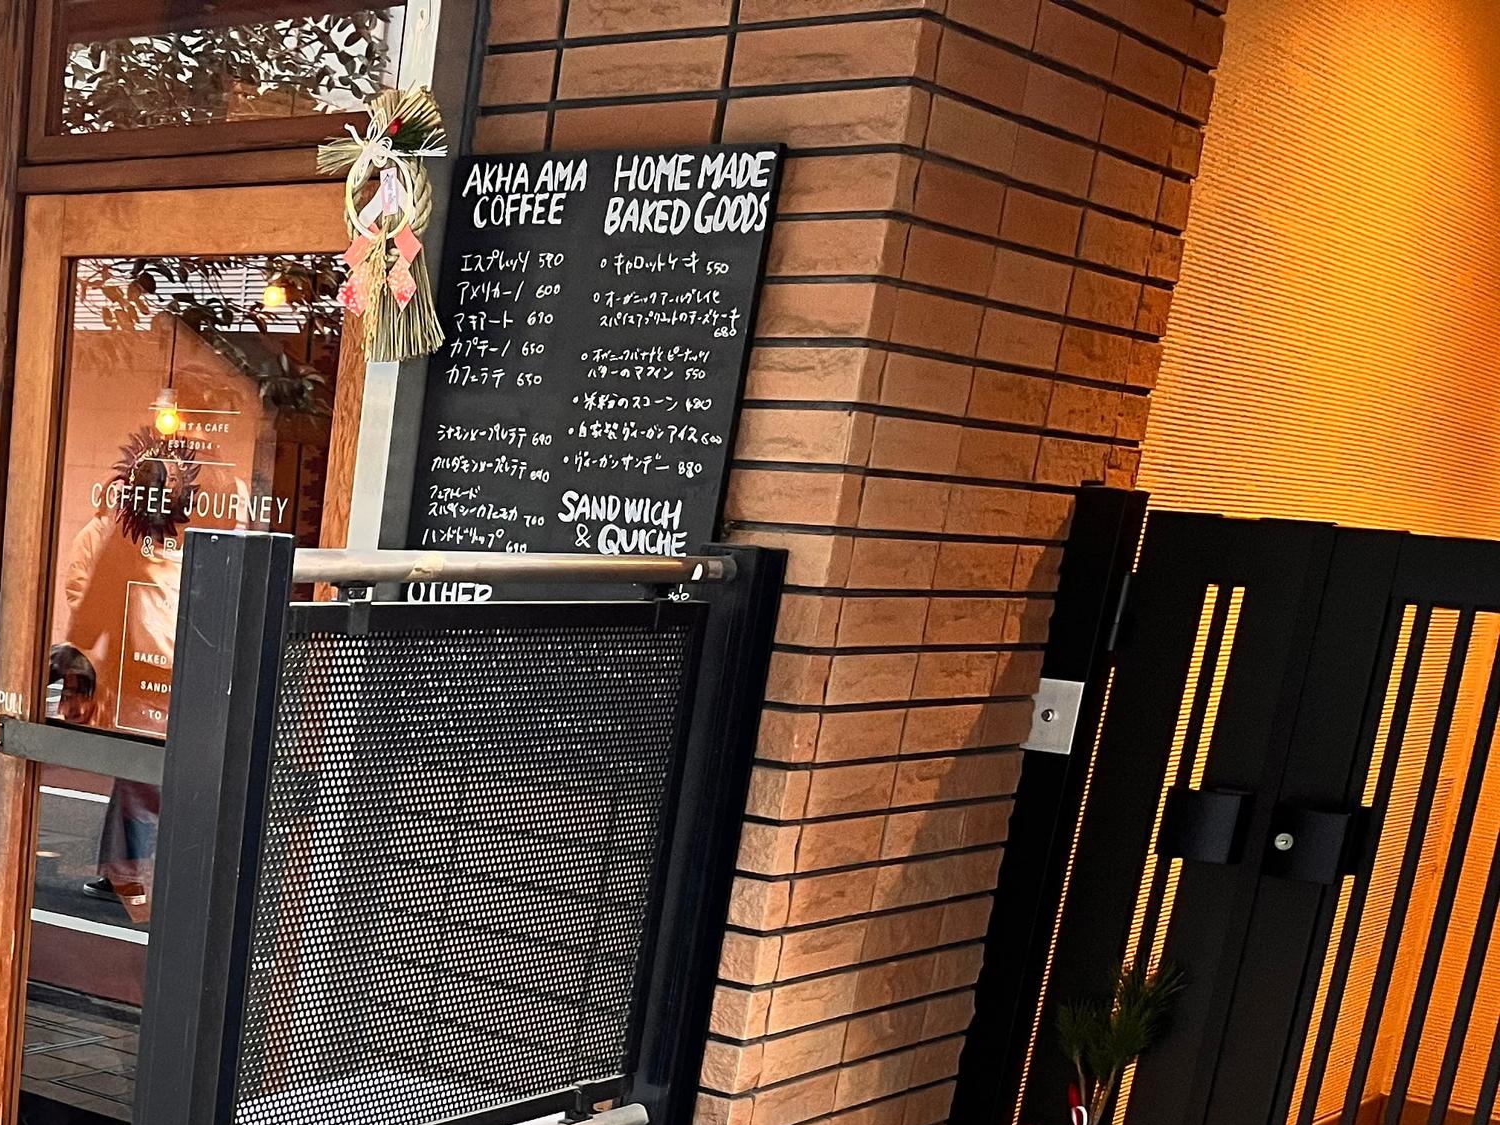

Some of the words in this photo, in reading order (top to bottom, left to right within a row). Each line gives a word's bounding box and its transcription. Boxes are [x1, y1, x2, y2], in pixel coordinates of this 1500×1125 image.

[462, 162, 535, 198] AKHA
[534, 159, 589, 192] AMA
[614, 153, 695, 193] HOME
[699, 151, 777, 191] MADE
[473, 193, 566, 229] COFFEE
[604, 197, 699, 236] BAKED
[696, 192, 770, 236] GOODS
[706, 261, 730, 275] 550
[456, 280, 525, 306] アメリカーノ
[535, 283, 561, 299] 600
[713, 326, 738, 338] 680
[521, 341, 545, 357] 650
[445, 364, 506, 389] カフェラテ
[516, 372, 543, 387] 650
[684, 367, 706, 381] 550
[204, 423, 230, 433] CAFE
[168, 440, 186, 449] EST
[189, 441, 212, 450] 2014
[91, 482, 173, 515] COFFEE
[183, 489, 289, 524] JOURNEY
[557, 490, 683, 531] SANDWICH
[140, 536, 155, 558] &
[574, 523, 592, 549] &
[597, 523, 688, 557] QUICHE
[133, 652, 168, 666] BAKED
